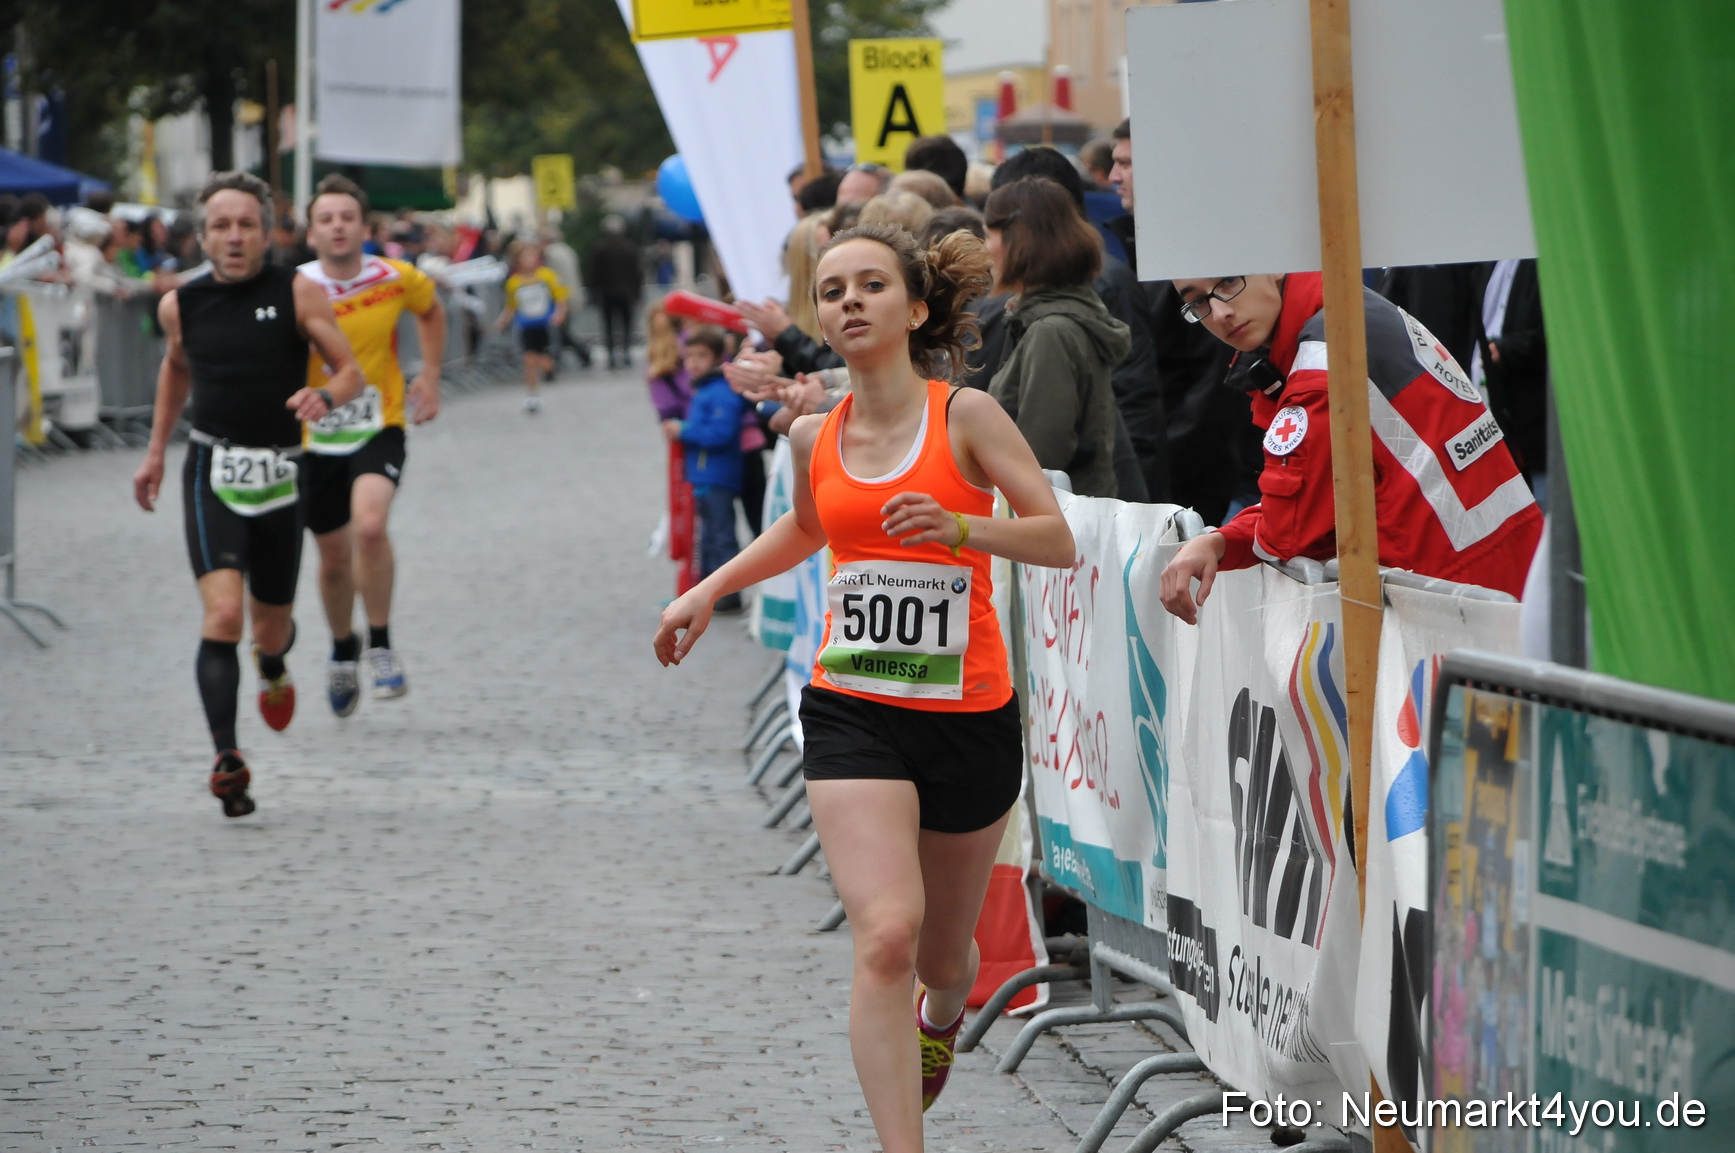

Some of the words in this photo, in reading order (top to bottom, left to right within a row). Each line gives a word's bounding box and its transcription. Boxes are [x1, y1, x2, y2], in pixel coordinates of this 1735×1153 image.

[863, 46, 935, 71] Block
[877, 84, 921, 148] A
[831, 573, 875, 586] PARTL
[877, 574, 946, 591] Neumarkt
[842, 593, 950, 647] 5001
[850, 653, 928, 679] Vanessa
